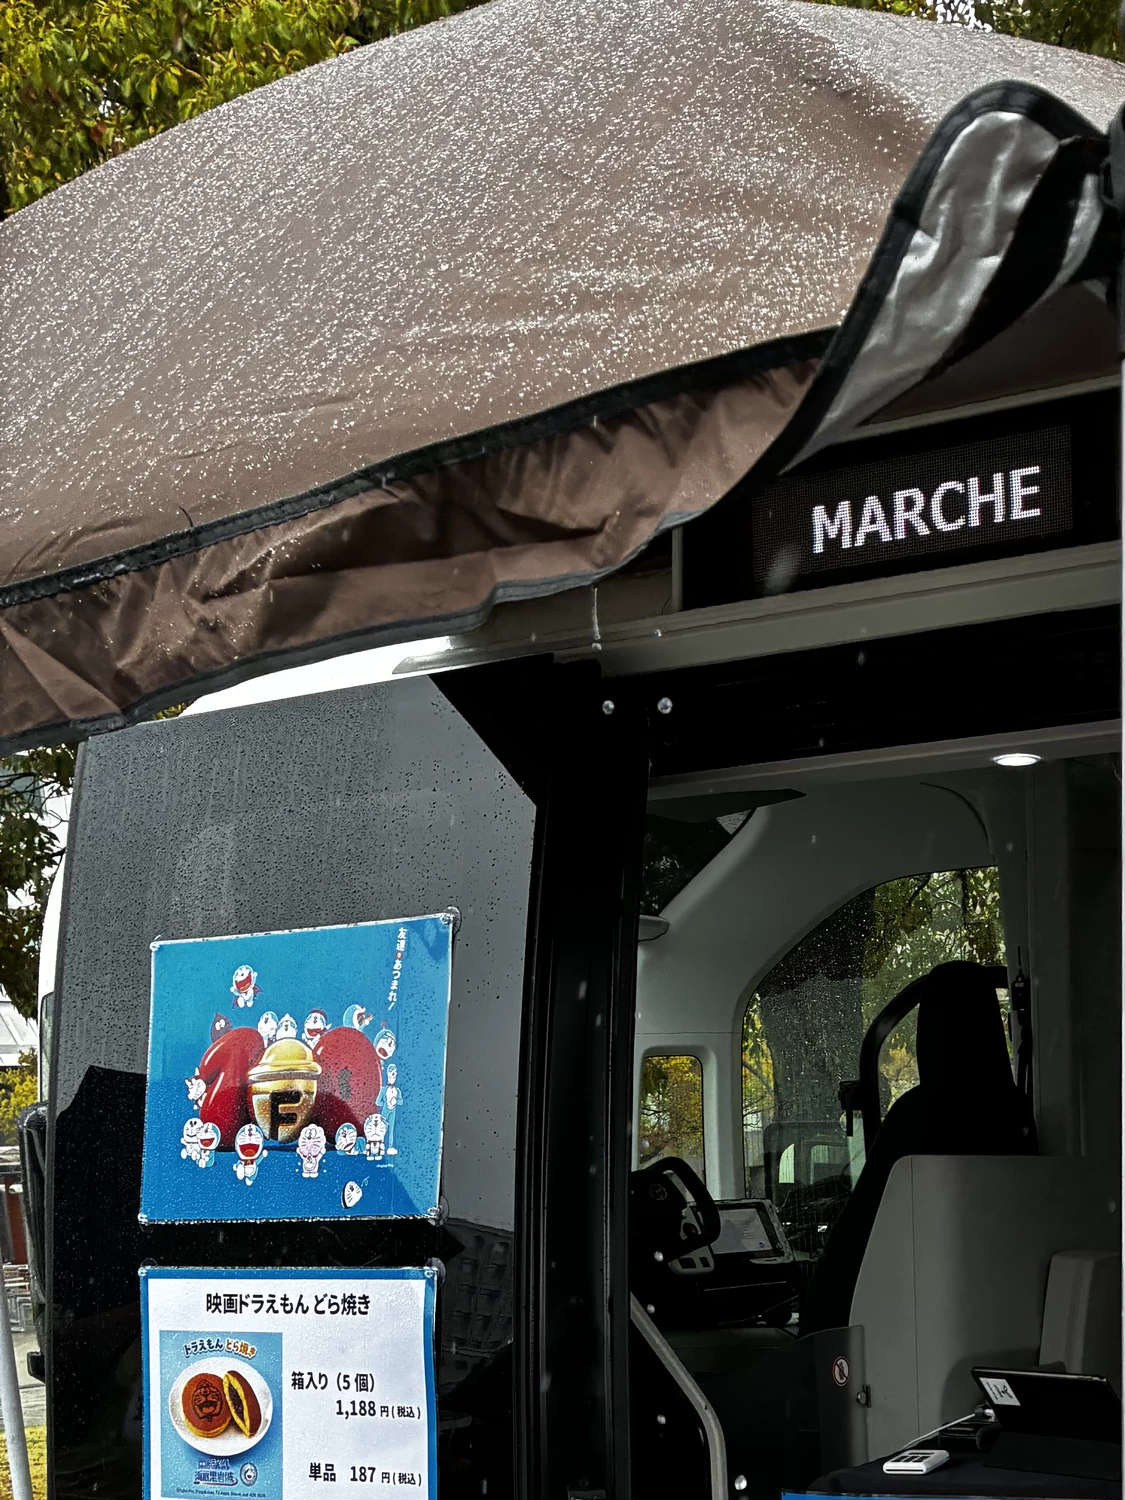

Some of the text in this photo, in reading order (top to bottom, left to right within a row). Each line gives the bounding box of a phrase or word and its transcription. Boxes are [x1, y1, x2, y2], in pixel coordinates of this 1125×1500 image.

[811, 465, 1041, 553] MARCHE
[206, 1292, 371, 1316] 映画ドラえもん どら焼き
[336, 1399, 377, 1420] 1,188
[308, 1462, 337, 1483] 単品
[349, 1466, 377, 1483] 187
